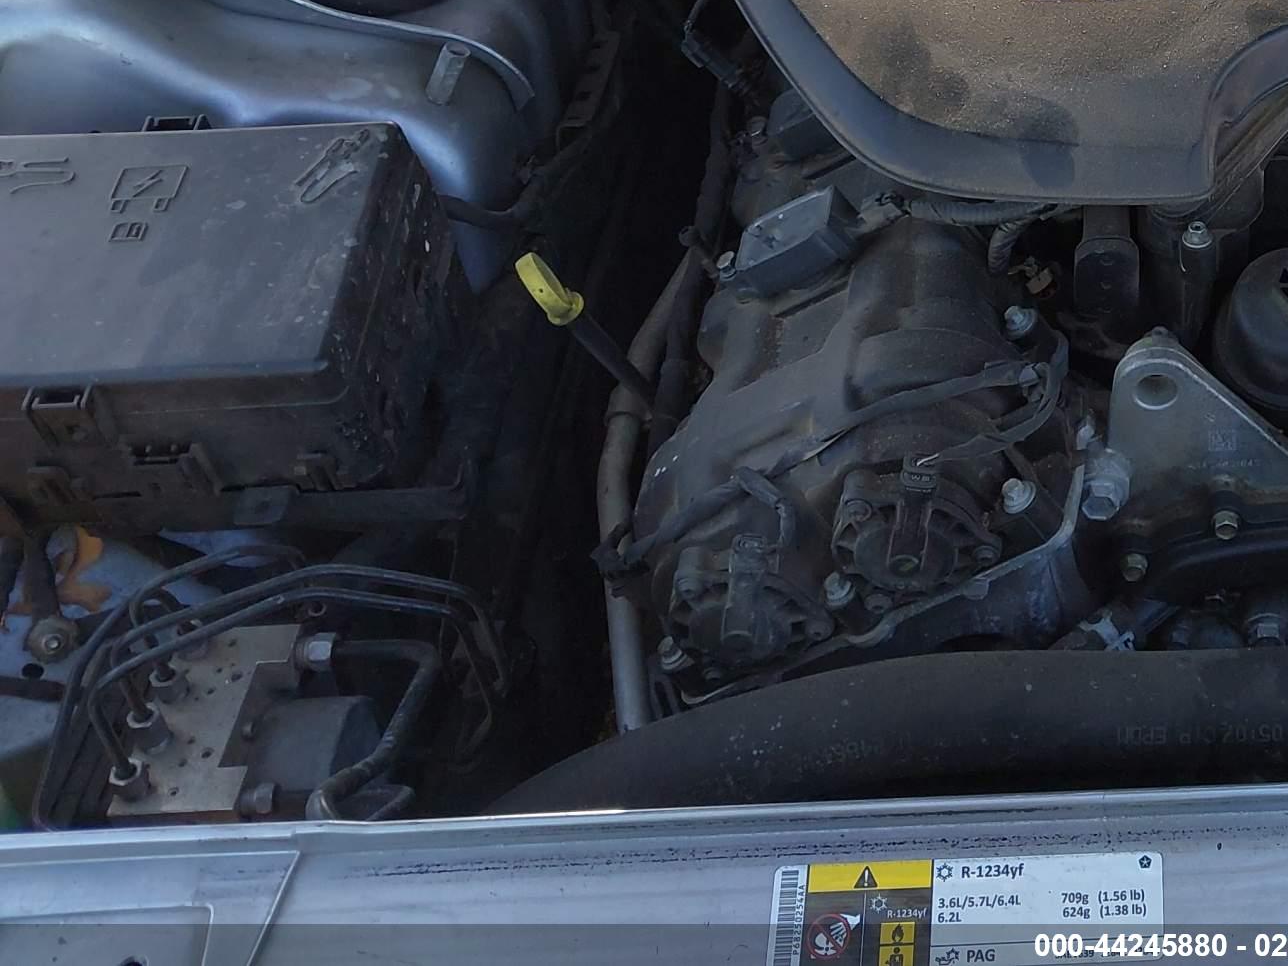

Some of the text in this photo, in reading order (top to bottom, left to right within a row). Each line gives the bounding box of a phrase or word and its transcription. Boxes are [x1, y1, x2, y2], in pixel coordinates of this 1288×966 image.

[961, 863, 1024, 880] R-1234yf
[938, 888, 1145, 910] 3.6L/5.7L/6.4L 709g (1.56 lb)
[887, 907, 927, 919] R-1234yf
[937, 903, 1147, 924] 6.2L 624g (1.38 lb)
[966, 949, 996, 962] PAG
